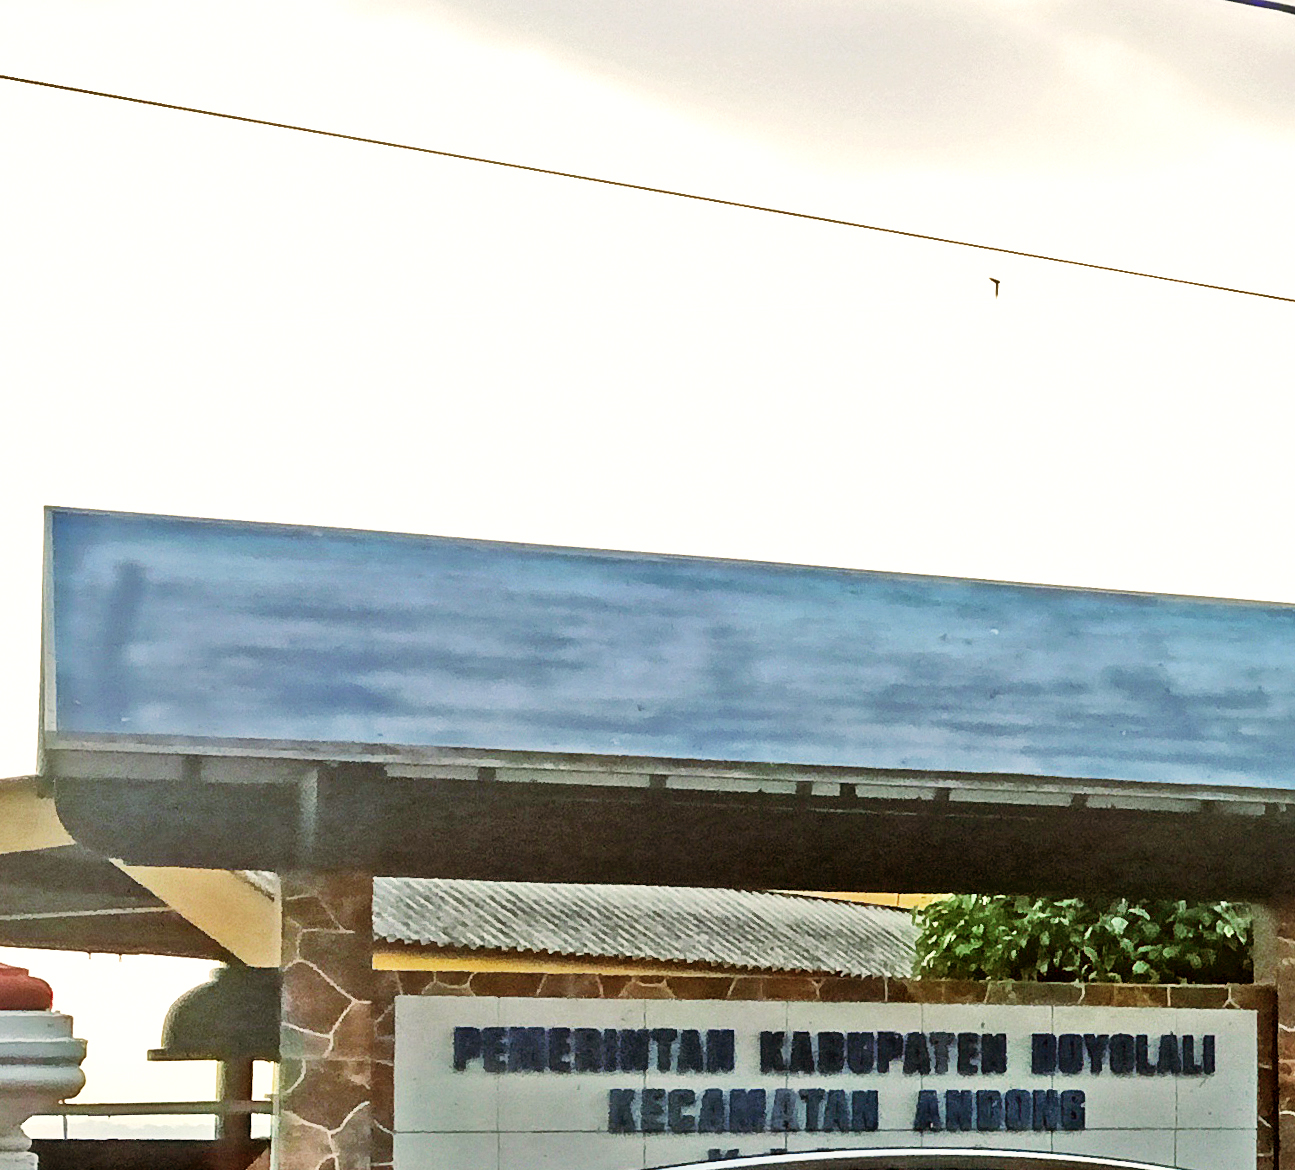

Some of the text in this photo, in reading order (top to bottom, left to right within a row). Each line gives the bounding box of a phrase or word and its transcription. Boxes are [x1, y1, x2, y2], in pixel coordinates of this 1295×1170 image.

[452, 1026, 1215, 1076] PEMERINTAH KABUPATEN BOYOLALI
[607, 1087, 1086, 1134] KECAMATAN ANDONG
